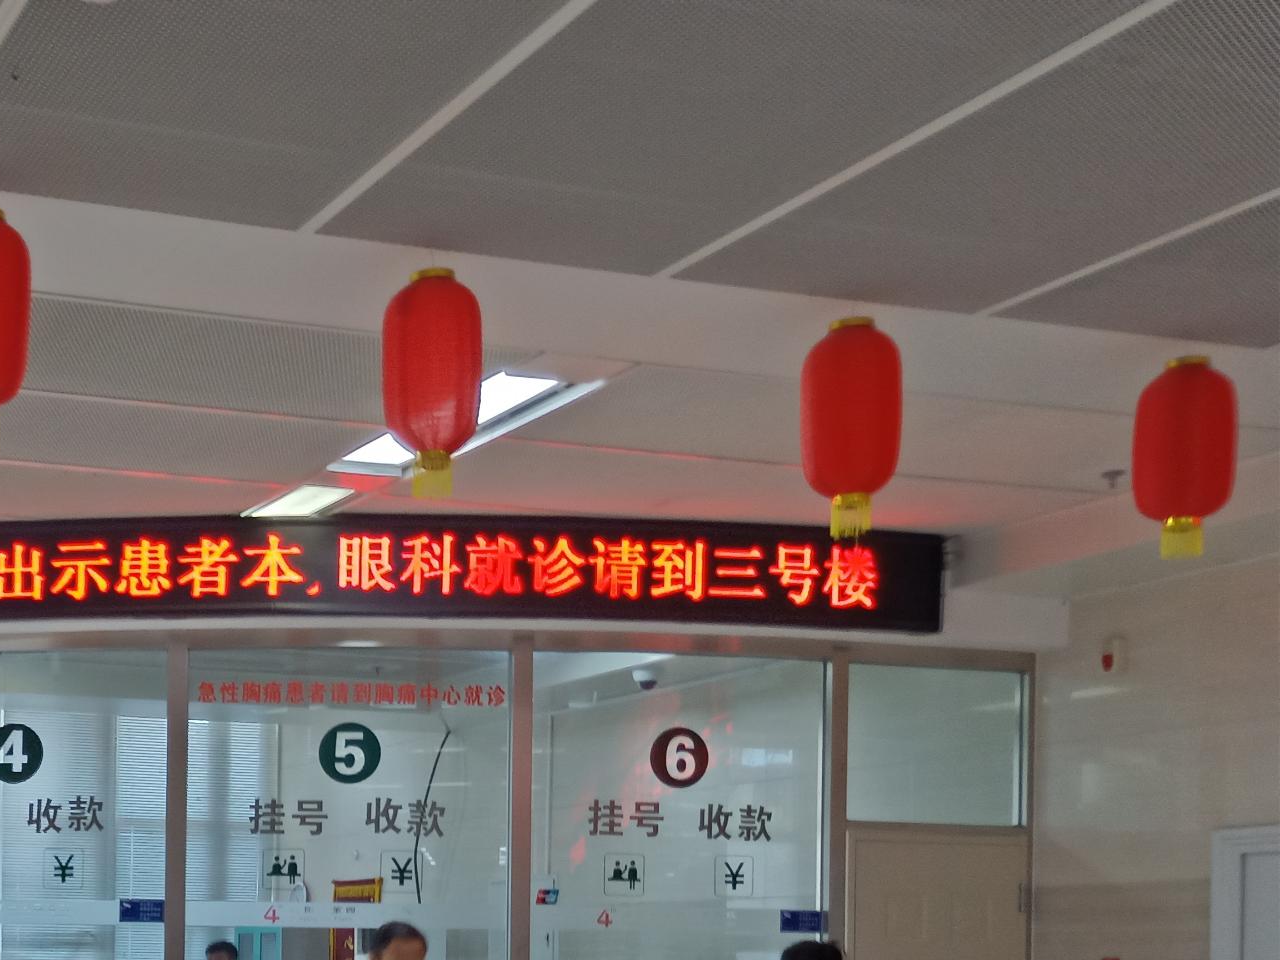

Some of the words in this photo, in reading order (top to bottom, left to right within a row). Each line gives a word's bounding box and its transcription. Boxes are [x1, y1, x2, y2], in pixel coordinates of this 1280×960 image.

[338, 531, 878, 609] 眼科就诊请到三号楼
[199, 680, 506, 708] 急性胸痛患者请到胸痛中心就诊
[27, 795, 104, 834] 收款
[248, 798, 328, 836] 挂号
[365, 797, 446, 838] 收款
[588, 799, 665, 838] 挂号
[698, 803, 773, 842] 收款
